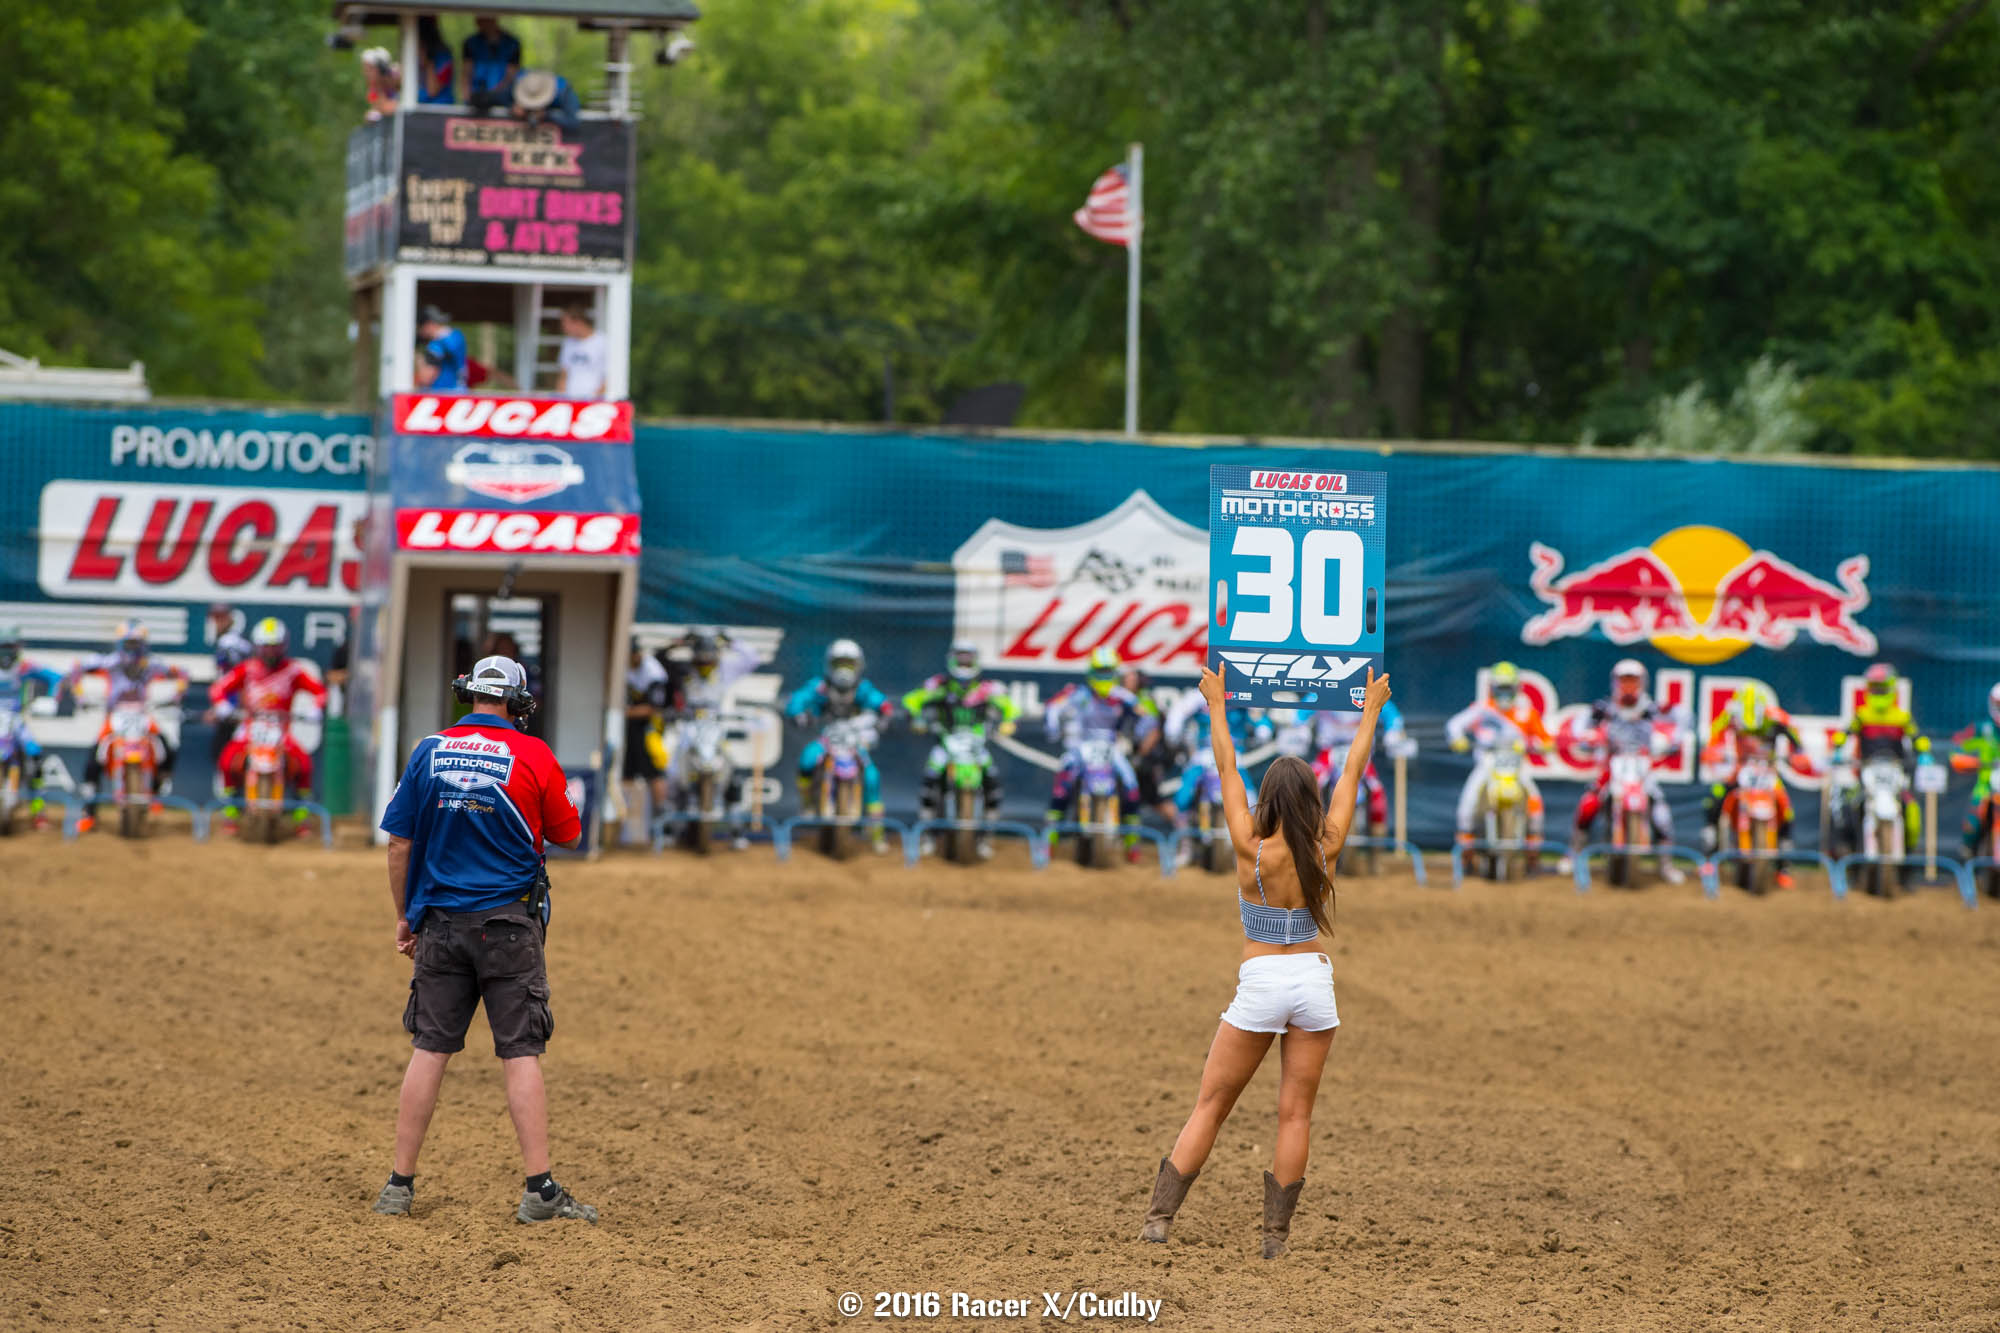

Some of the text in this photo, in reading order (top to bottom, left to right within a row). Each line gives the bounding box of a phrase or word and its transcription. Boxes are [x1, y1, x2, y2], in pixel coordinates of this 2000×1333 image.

[405, 397, 619, 439] LUCAS
[1254, 472, 1344, 492] LUCAS OIL
[1221, 497, 1375, 520] MOTOCROSS
[1221, 514, 1375, 527] CHAMPIONSHIP
[408, 512, 623, 552] LUCAS
[1229, 526, 1364, 645] 30
[1218, 651, 1373, 681] FLY
[1250, 679, 1339, 689] RACING
[445, 740, 501, 754] LUCAS OIL
[434, 757, 508, 774] MOTOCROSS
[448, 799, 468, 809] NBC
